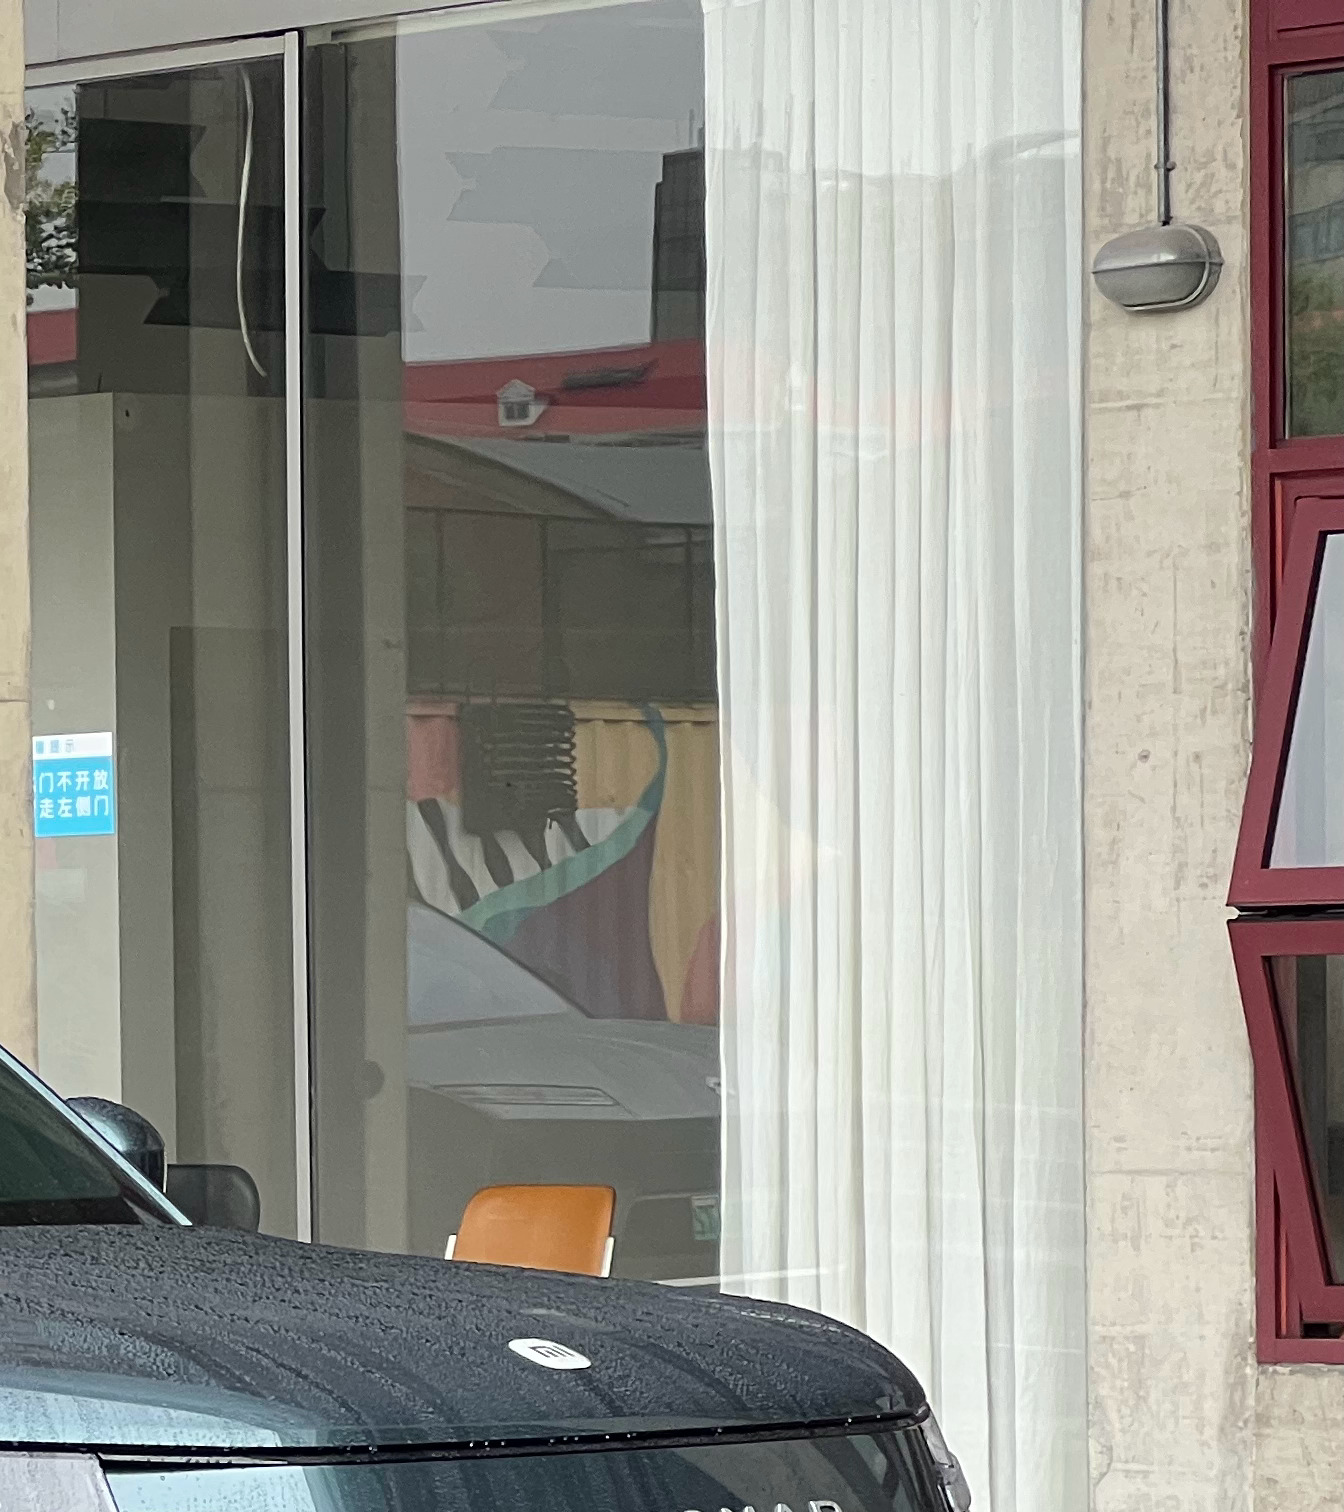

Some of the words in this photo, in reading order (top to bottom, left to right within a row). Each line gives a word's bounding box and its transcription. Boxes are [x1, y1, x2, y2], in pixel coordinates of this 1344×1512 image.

[33, 769, 109, 794] 门不开放
[34, 795, 109, 818] 走左侧门
